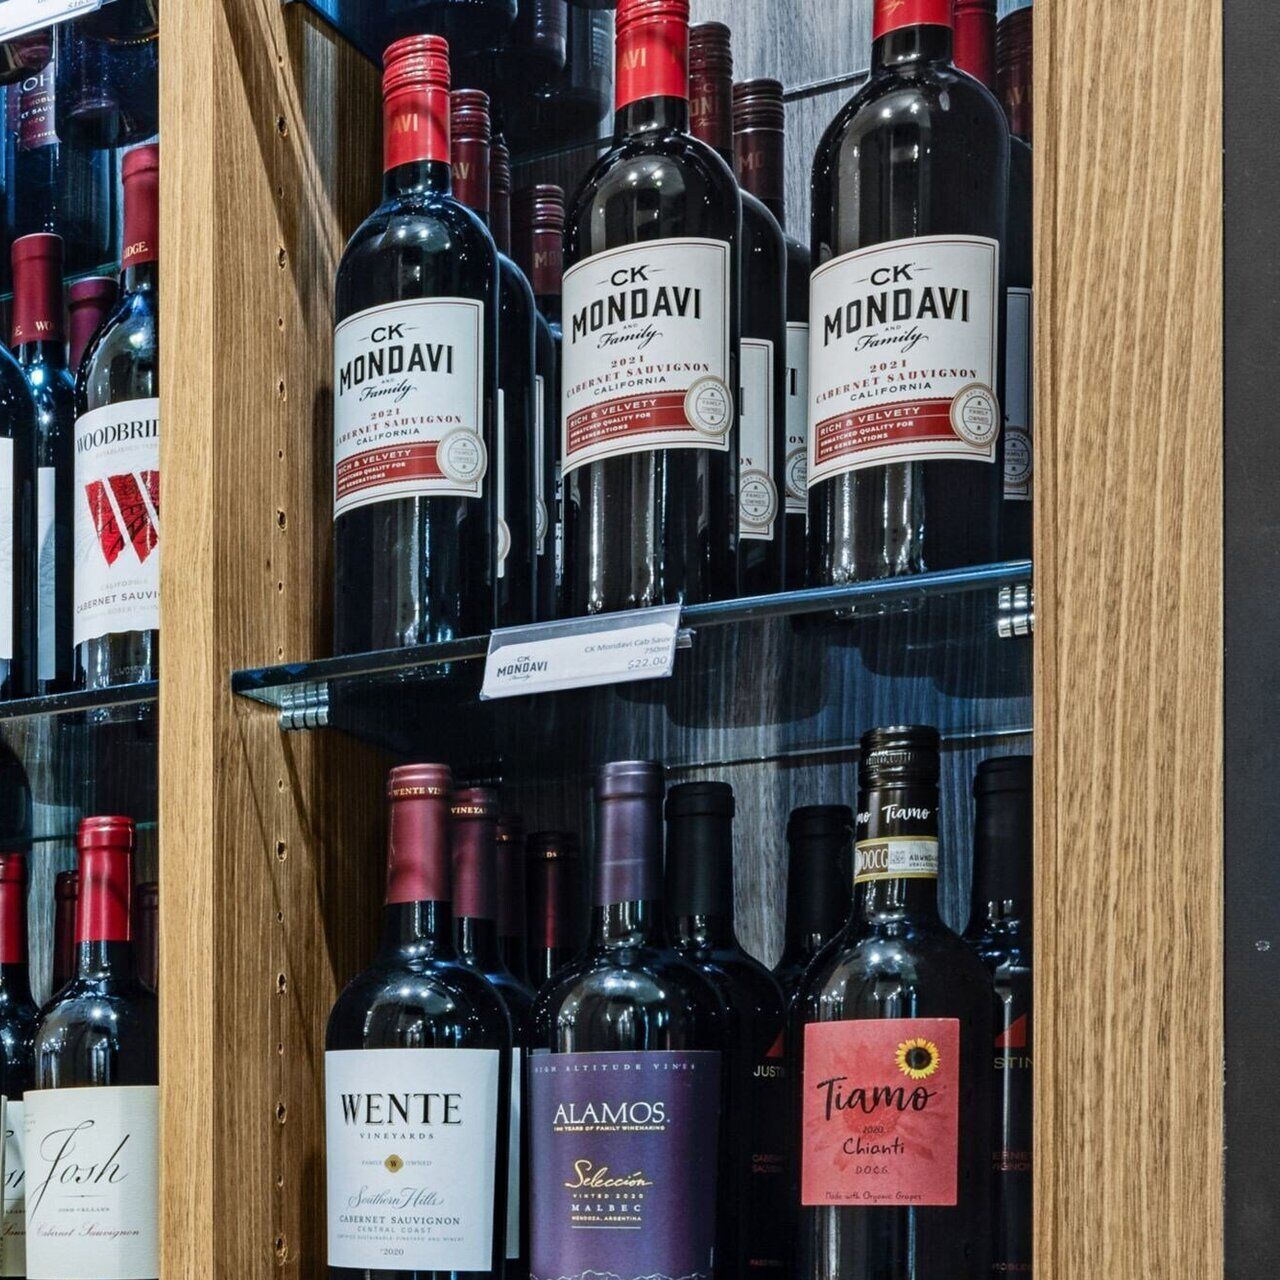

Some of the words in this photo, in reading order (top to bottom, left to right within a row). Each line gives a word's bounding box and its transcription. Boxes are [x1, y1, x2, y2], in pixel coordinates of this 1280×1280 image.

[610, 265, 648, 286] CK
[870, 262, 914, 285] CK
[572, 286, 702, 344] MONDAVI
[823, 286, 970, 347] MONDAVI
[370, 323, 404, 343] CK
[597, 328, 663, 349] Family
[855, 325, 929, 353] Family
[339, 344, 454, 396] MONDAVI
[888, 369, 978, 384] SAUVIGNON
[358, 382, 417, 403] Family
[850, 382, 931, 401] CALIFORNIA
[497, 661, 548, 678] MONDAVI
[628, 656, 667, 670] $22.00
[882, 804, 931, 824] Tiamo
[341, 1092, 463, 1126] WENTE
[816, 1075, 937, 1123] Tiamo
[552, 1102, 665, 1124] ALAMOS
[842, 1138, 905, 1156] Chianti
[32, 1119, 131, 1222] Josh
[571, 1204, 642, 1212] MALBEC
[339, 1215, 386, 1225] CABERNET
[391, 1216, 461, 1226] SAUVIGNON
